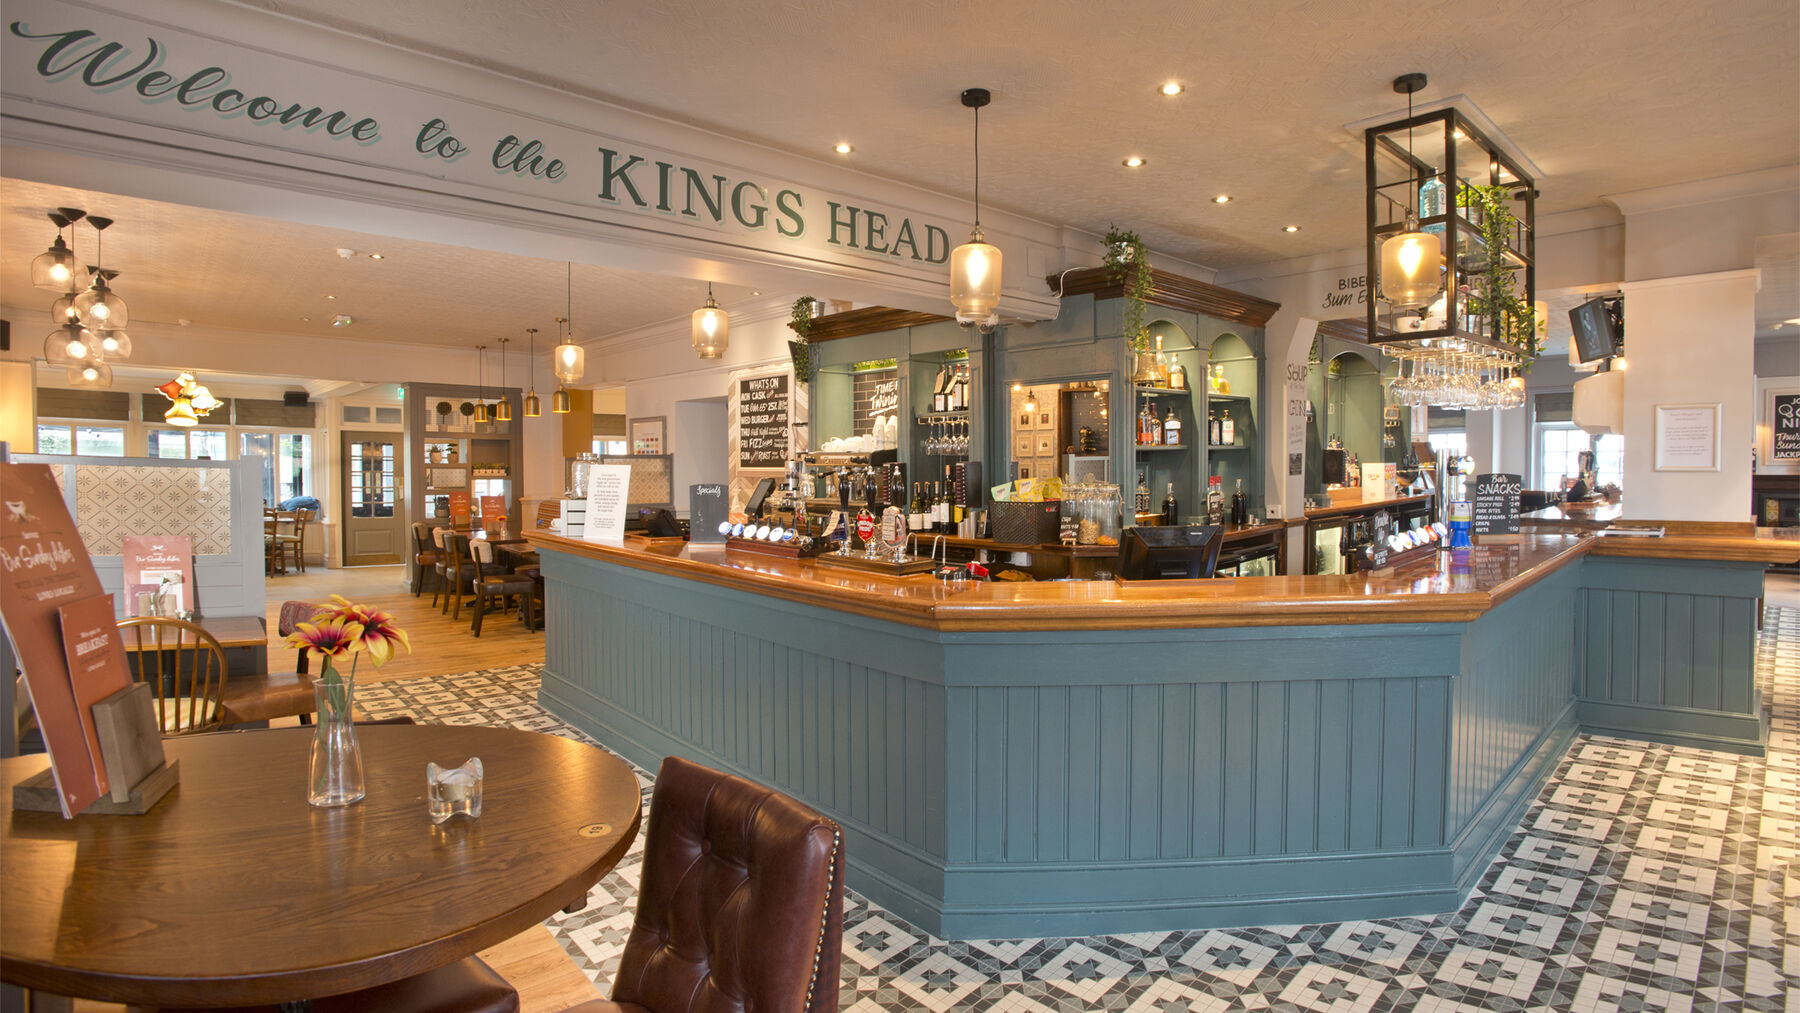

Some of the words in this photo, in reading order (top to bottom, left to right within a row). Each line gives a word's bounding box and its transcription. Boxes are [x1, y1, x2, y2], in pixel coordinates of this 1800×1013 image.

[10, 20, 381, 144] Welcome
[415, 118, 468, 160] to
[491, 134, 567, 181] the
[597, 146, 806, 240] KINGS
[826, 200, 951, 265] HEAD
[770, 377, 779, 389] ON
[752, 390, 766, 400] CASK
[751, 414, 769, 424] BURGER
[696, 485, 721, 499] Specials
[1476, 483, 1521, 495] SNACKS
